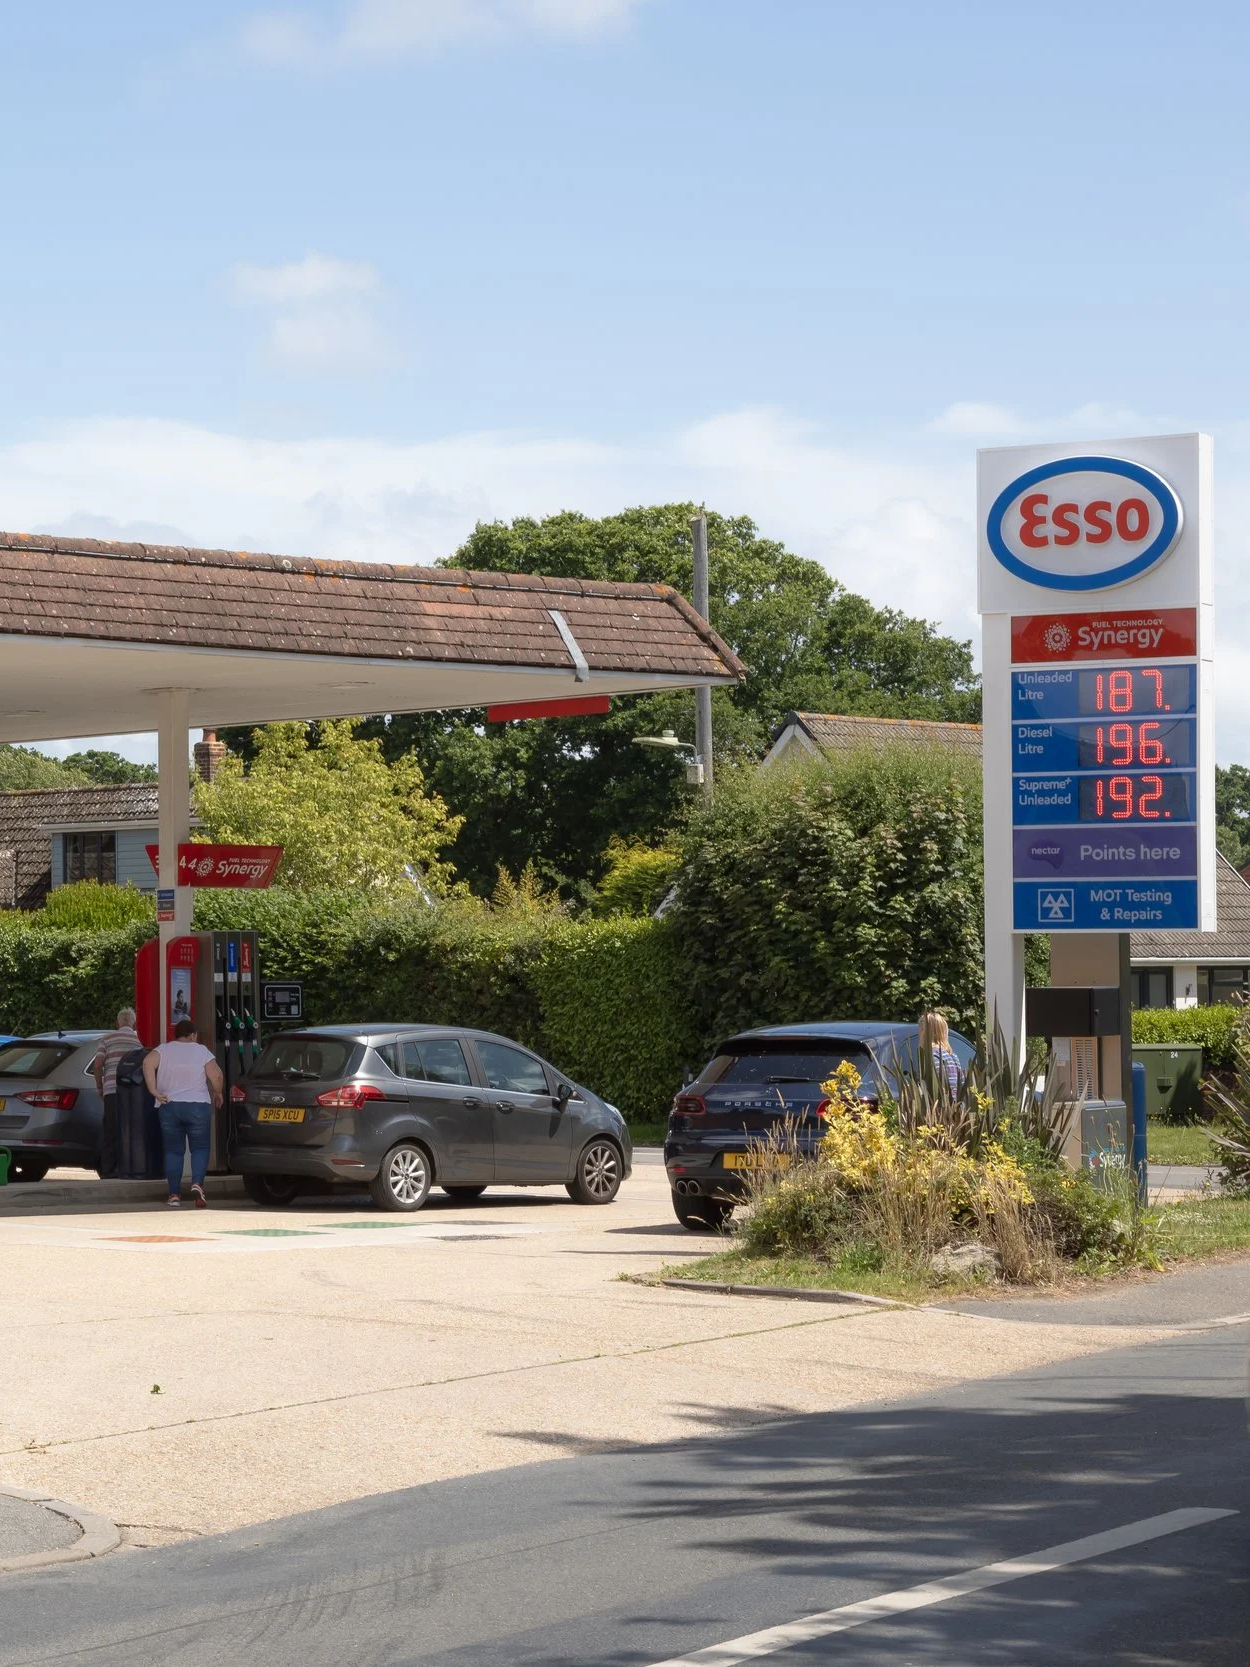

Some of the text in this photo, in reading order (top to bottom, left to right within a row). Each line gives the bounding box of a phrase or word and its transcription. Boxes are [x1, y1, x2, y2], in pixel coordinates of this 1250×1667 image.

[1113, 618, 1164, 628] TECHNOLOGY
[1077, 625, 1164, 649] Synergy
[1018, 671, 1073, 685] Unleaded
[1018, 688, 1045, 701] Litre
[1018, 726, 1053, 739] Diesel
[1018, 742, 1045, 755] Litre
[1018, 793, 1072, 806] Unleaded
[1030, 845, 1061, 855] nectar
[1080, 843, 1181, 861] Points here
[179, 855, 186, 869] 4
[188, 858, 197, 870] 4
[216, 861, 269, 878] Synergy
[1090, 888, 1173, 905] MOT Testing
[1100, 907, 1163, 923] & Repairs
[1170, 1051, 1179, 1059] 24
[263, 1109, 300, 1120] SP15 XCU
